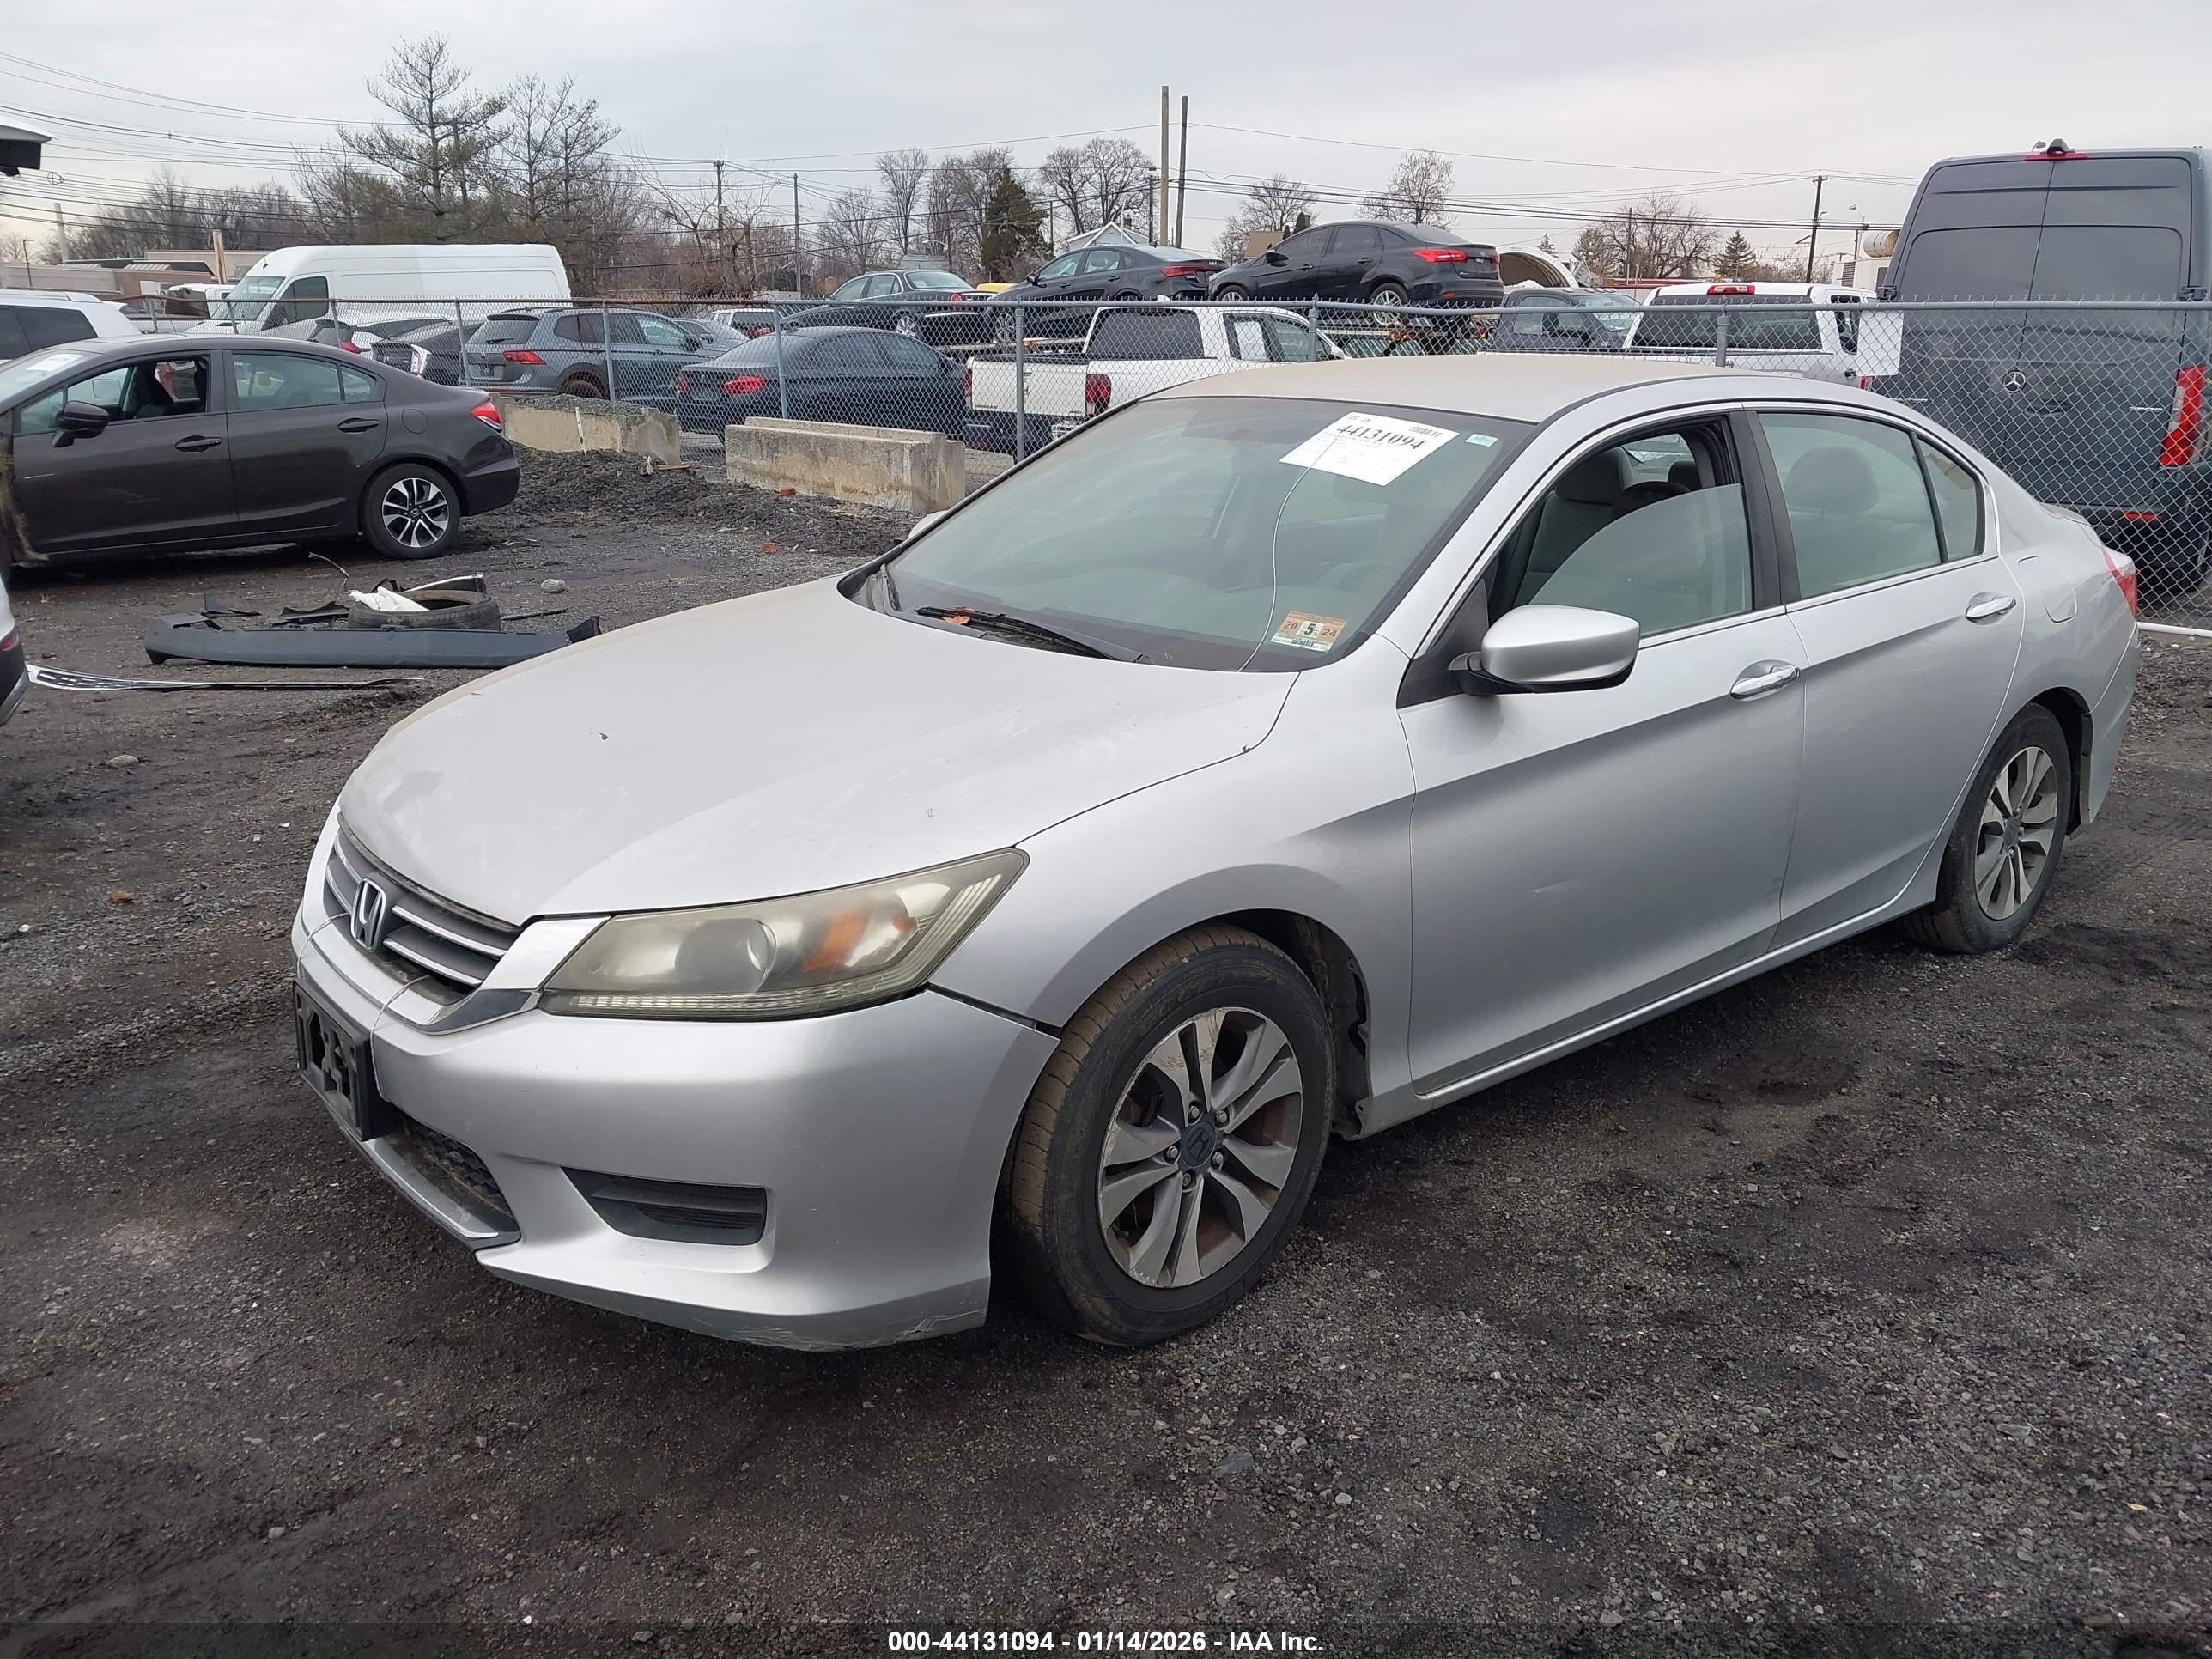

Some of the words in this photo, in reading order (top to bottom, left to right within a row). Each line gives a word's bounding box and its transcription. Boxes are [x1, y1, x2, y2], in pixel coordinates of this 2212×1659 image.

[1337, 424, 1427, 449] 44131094
[1284, 621, 1298, 630] 20
[1304, 623, 1316, 636] 5
[1322, 628, 1337, 638] 24
